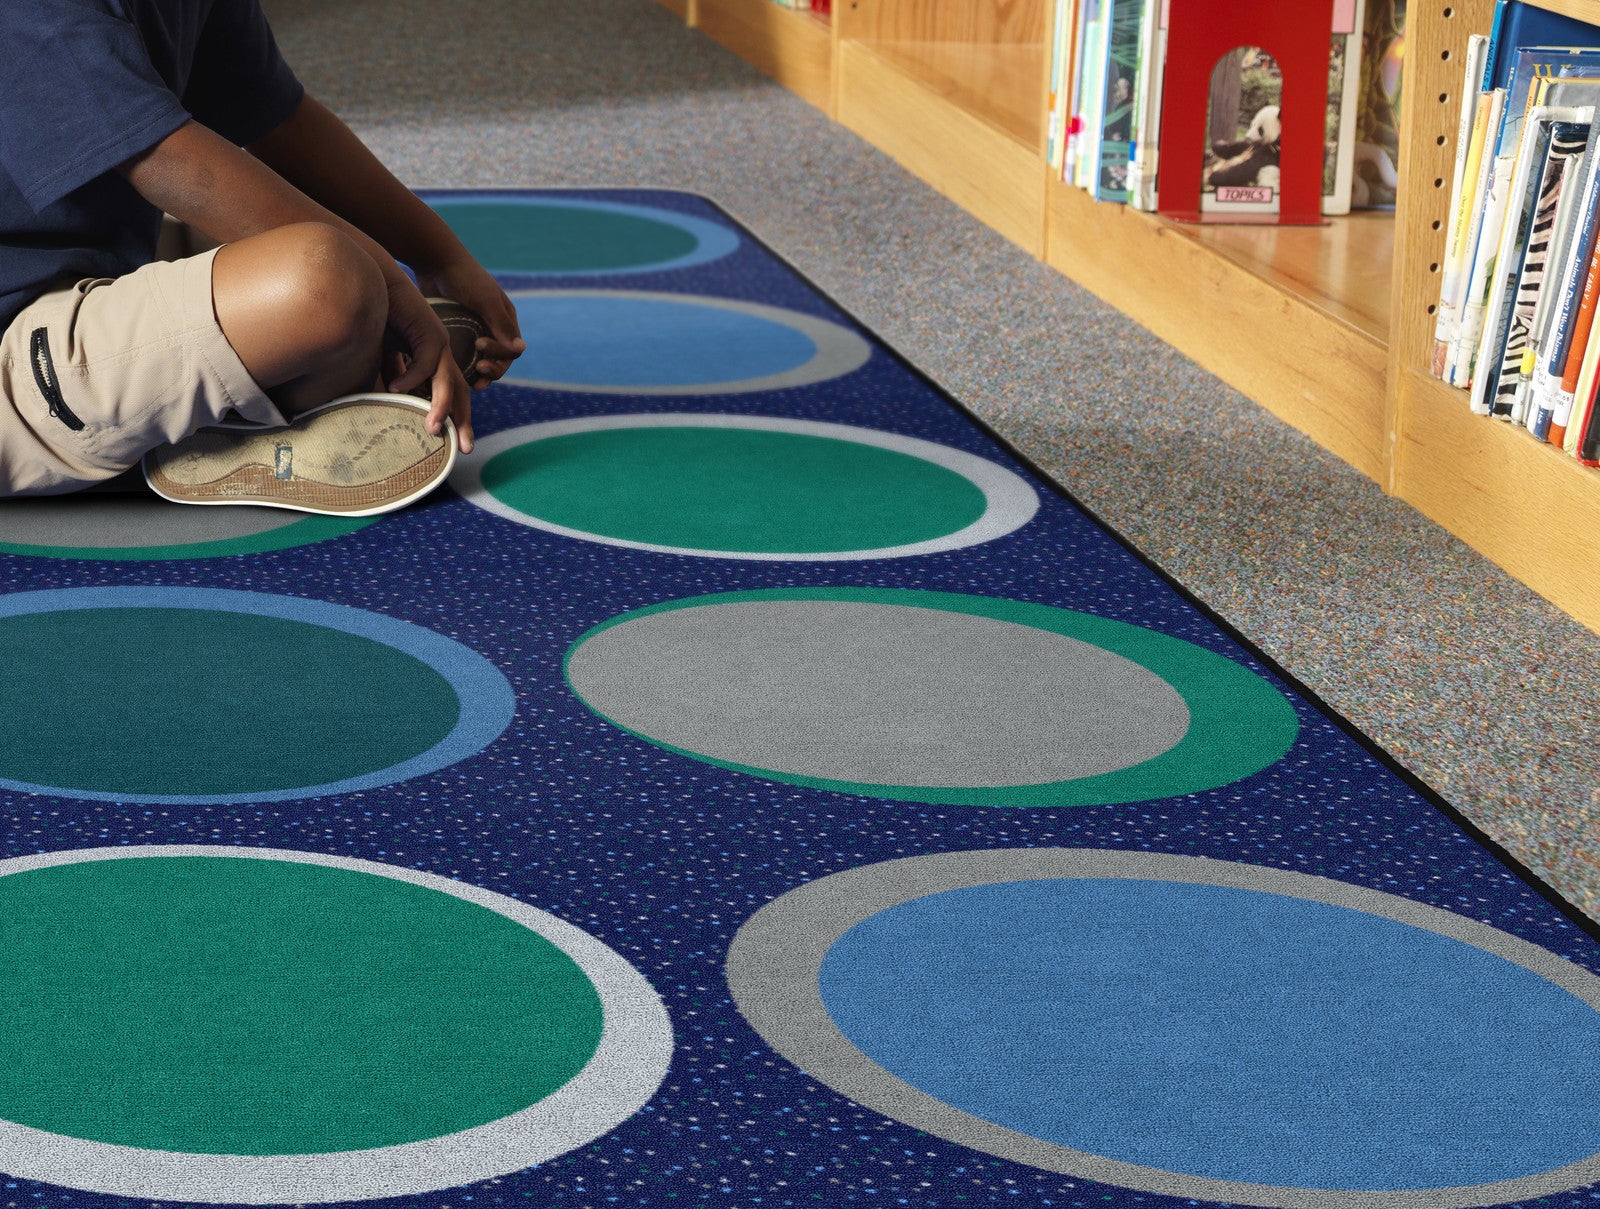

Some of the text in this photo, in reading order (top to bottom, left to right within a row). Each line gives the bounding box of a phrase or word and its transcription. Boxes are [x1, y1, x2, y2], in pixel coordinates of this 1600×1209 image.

[1485, 39, 1494, 85] ANIMALS
[1225, 189, 1264, 200] TOPICS
[1569, 256, 1582, 290] Animals
[1590, 257, 1598, 270] BE
[1584, 272, 1594, 300] EARLY
[1564, 291, 1574, 311] Don't
[1559, 313, 1569, 331] Wear
